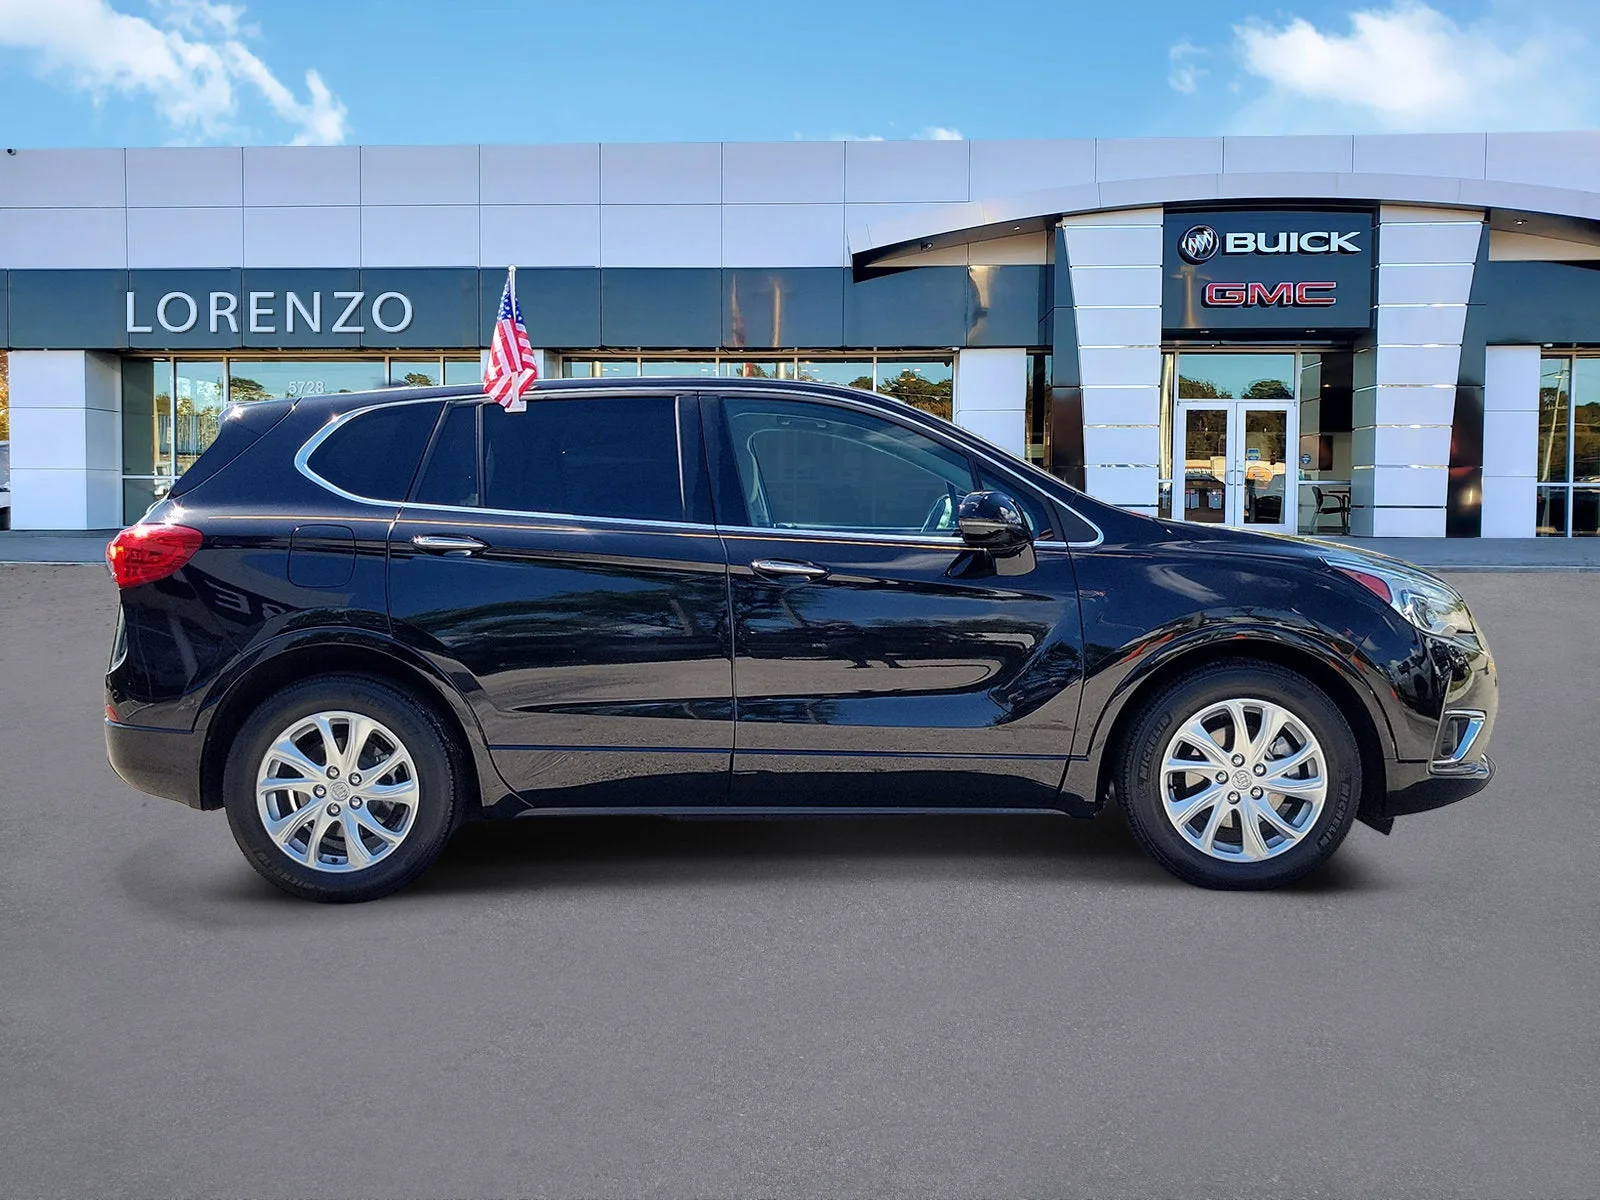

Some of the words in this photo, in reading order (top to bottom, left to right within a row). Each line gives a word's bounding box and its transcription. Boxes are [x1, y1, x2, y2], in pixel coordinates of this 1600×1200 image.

[1225, 231, 1362, 253] BUICK
[1206, 282, 1336, 305] GMC
[126, 291, 413, 333] LORENZO
[288, 380, 325, 395] 5728
[1319, 782, 1351, 849] MICHELIN
